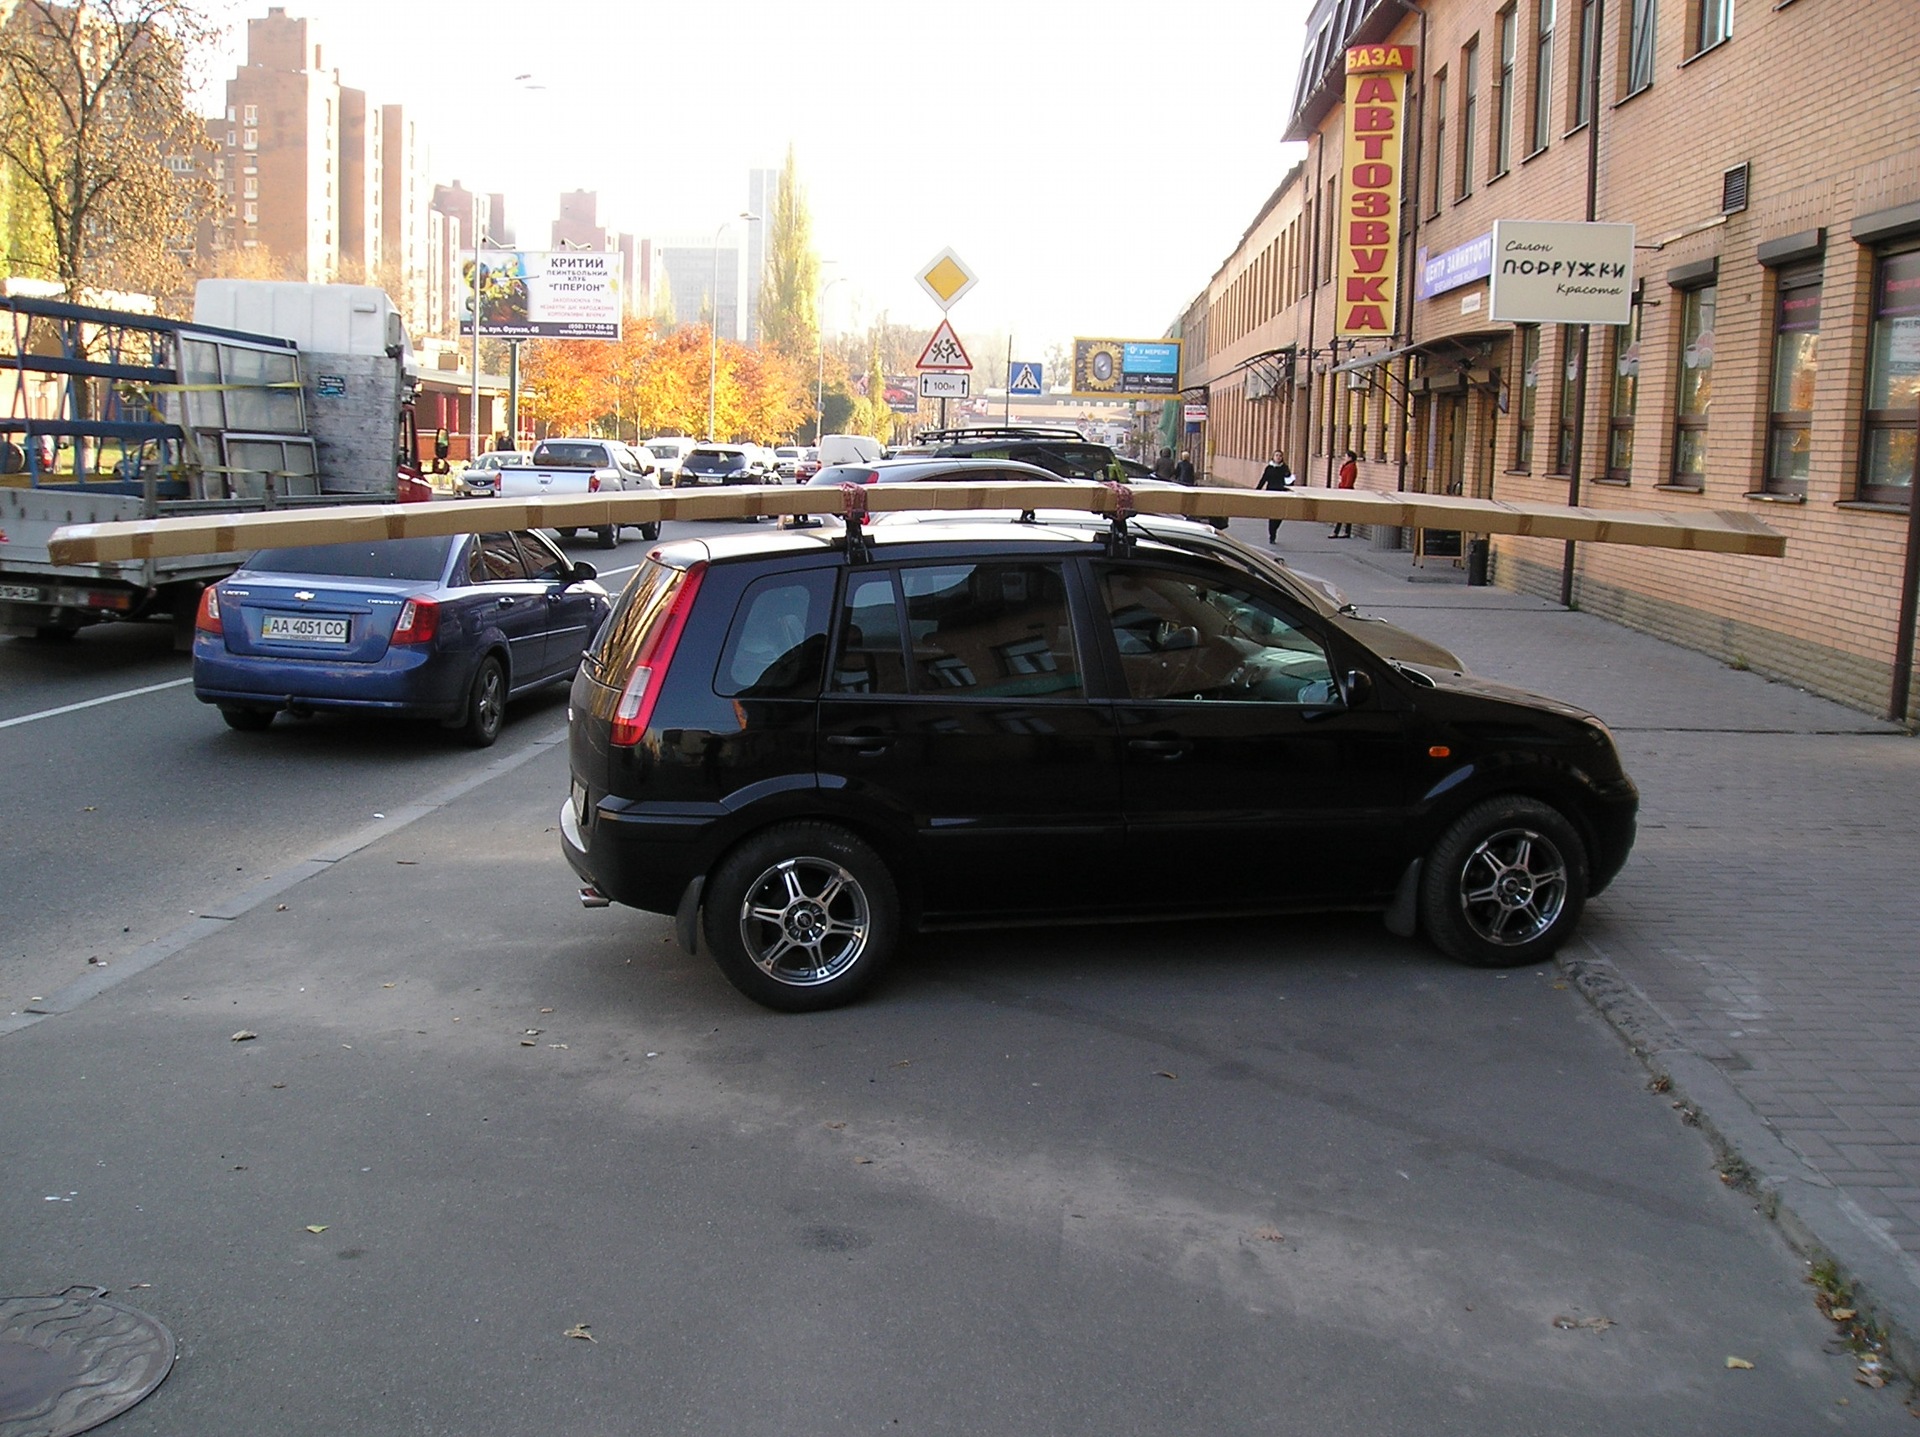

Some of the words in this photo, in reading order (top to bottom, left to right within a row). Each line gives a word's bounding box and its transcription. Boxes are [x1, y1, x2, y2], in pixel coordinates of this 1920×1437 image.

[1348, 48, 1402, 68] БАЗА
[1345, 77, 1397, 330] АВТОЗВУКА
[1505, 240, 1553, 252] Салон
[551, 257, 604, 268] КРИТИЙ
[1556, 283, 1623, 296] Красоты
[271, 619, 289, 633] AA
[293, 621, 321, 635] 4051
[325, 622, 344, 636] CO
